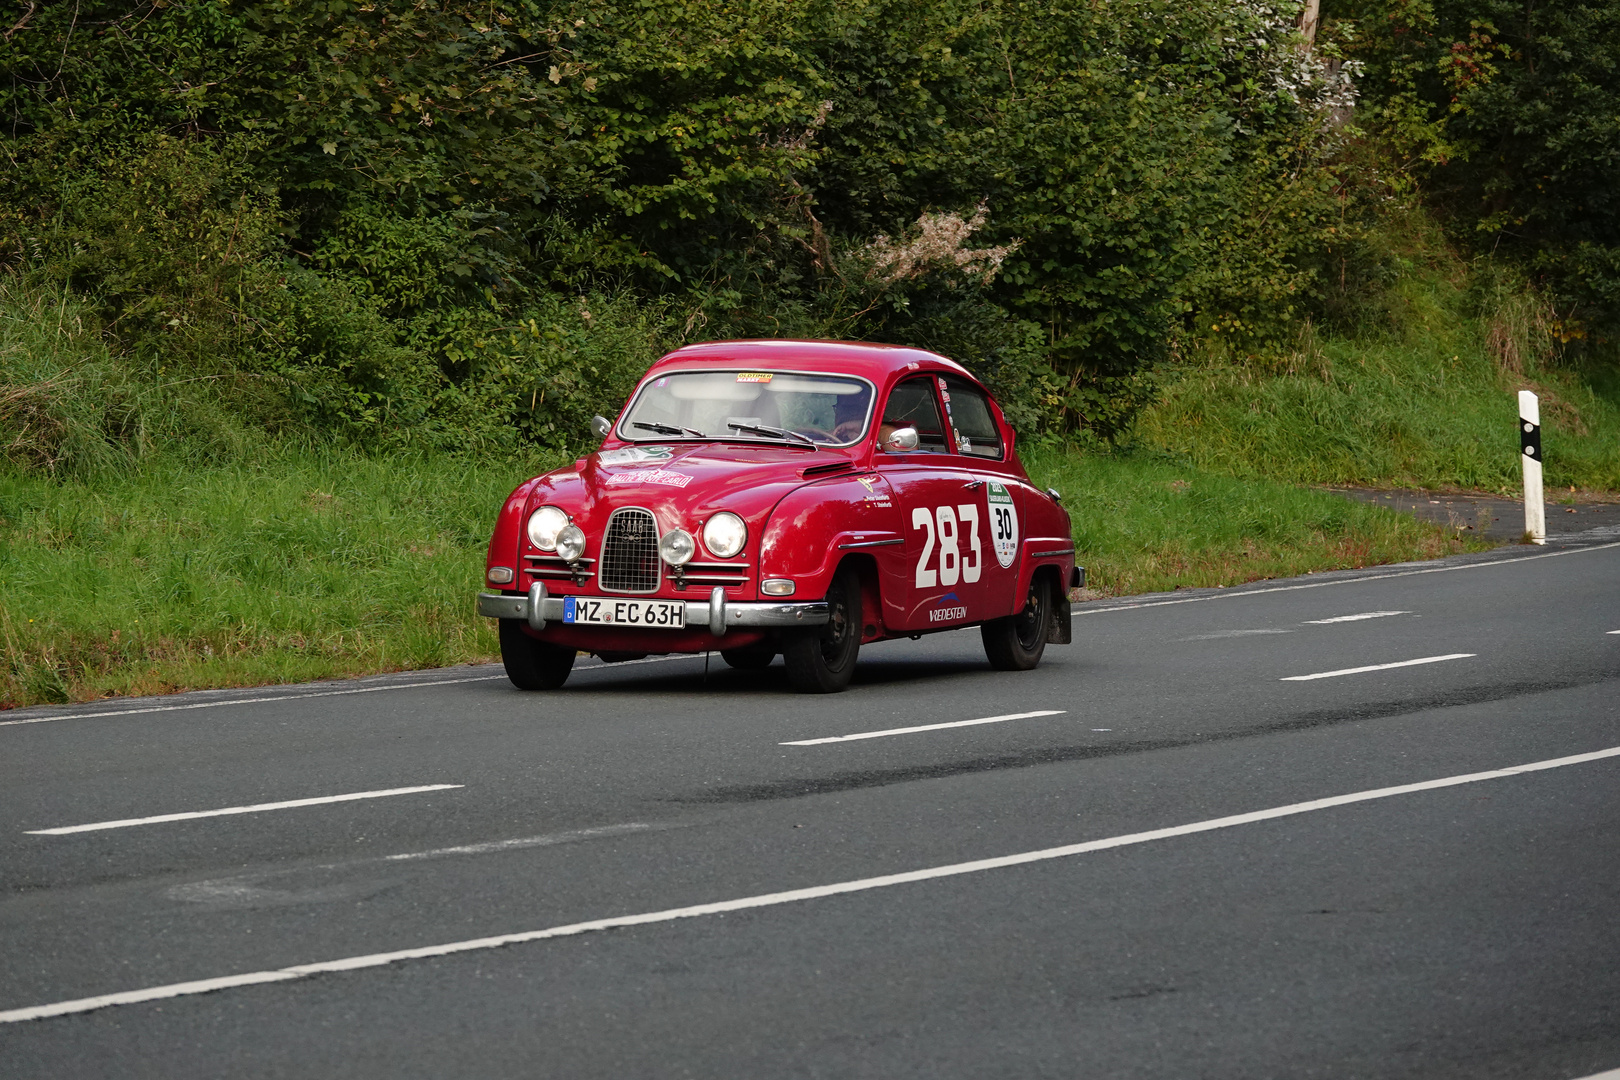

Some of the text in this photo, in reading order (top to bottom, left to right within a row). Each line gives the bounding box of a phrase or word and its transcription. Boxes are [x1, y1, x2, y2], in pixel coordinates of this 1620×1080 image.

[621, 520, 644, 534] SAAB
[995, 508, 1012, 540] 30
[912, 504, 982, 589] 283
[576, 600, 683, 626] MZ EC 63H
[929, 606, 968, 622] VREDESTEIN
